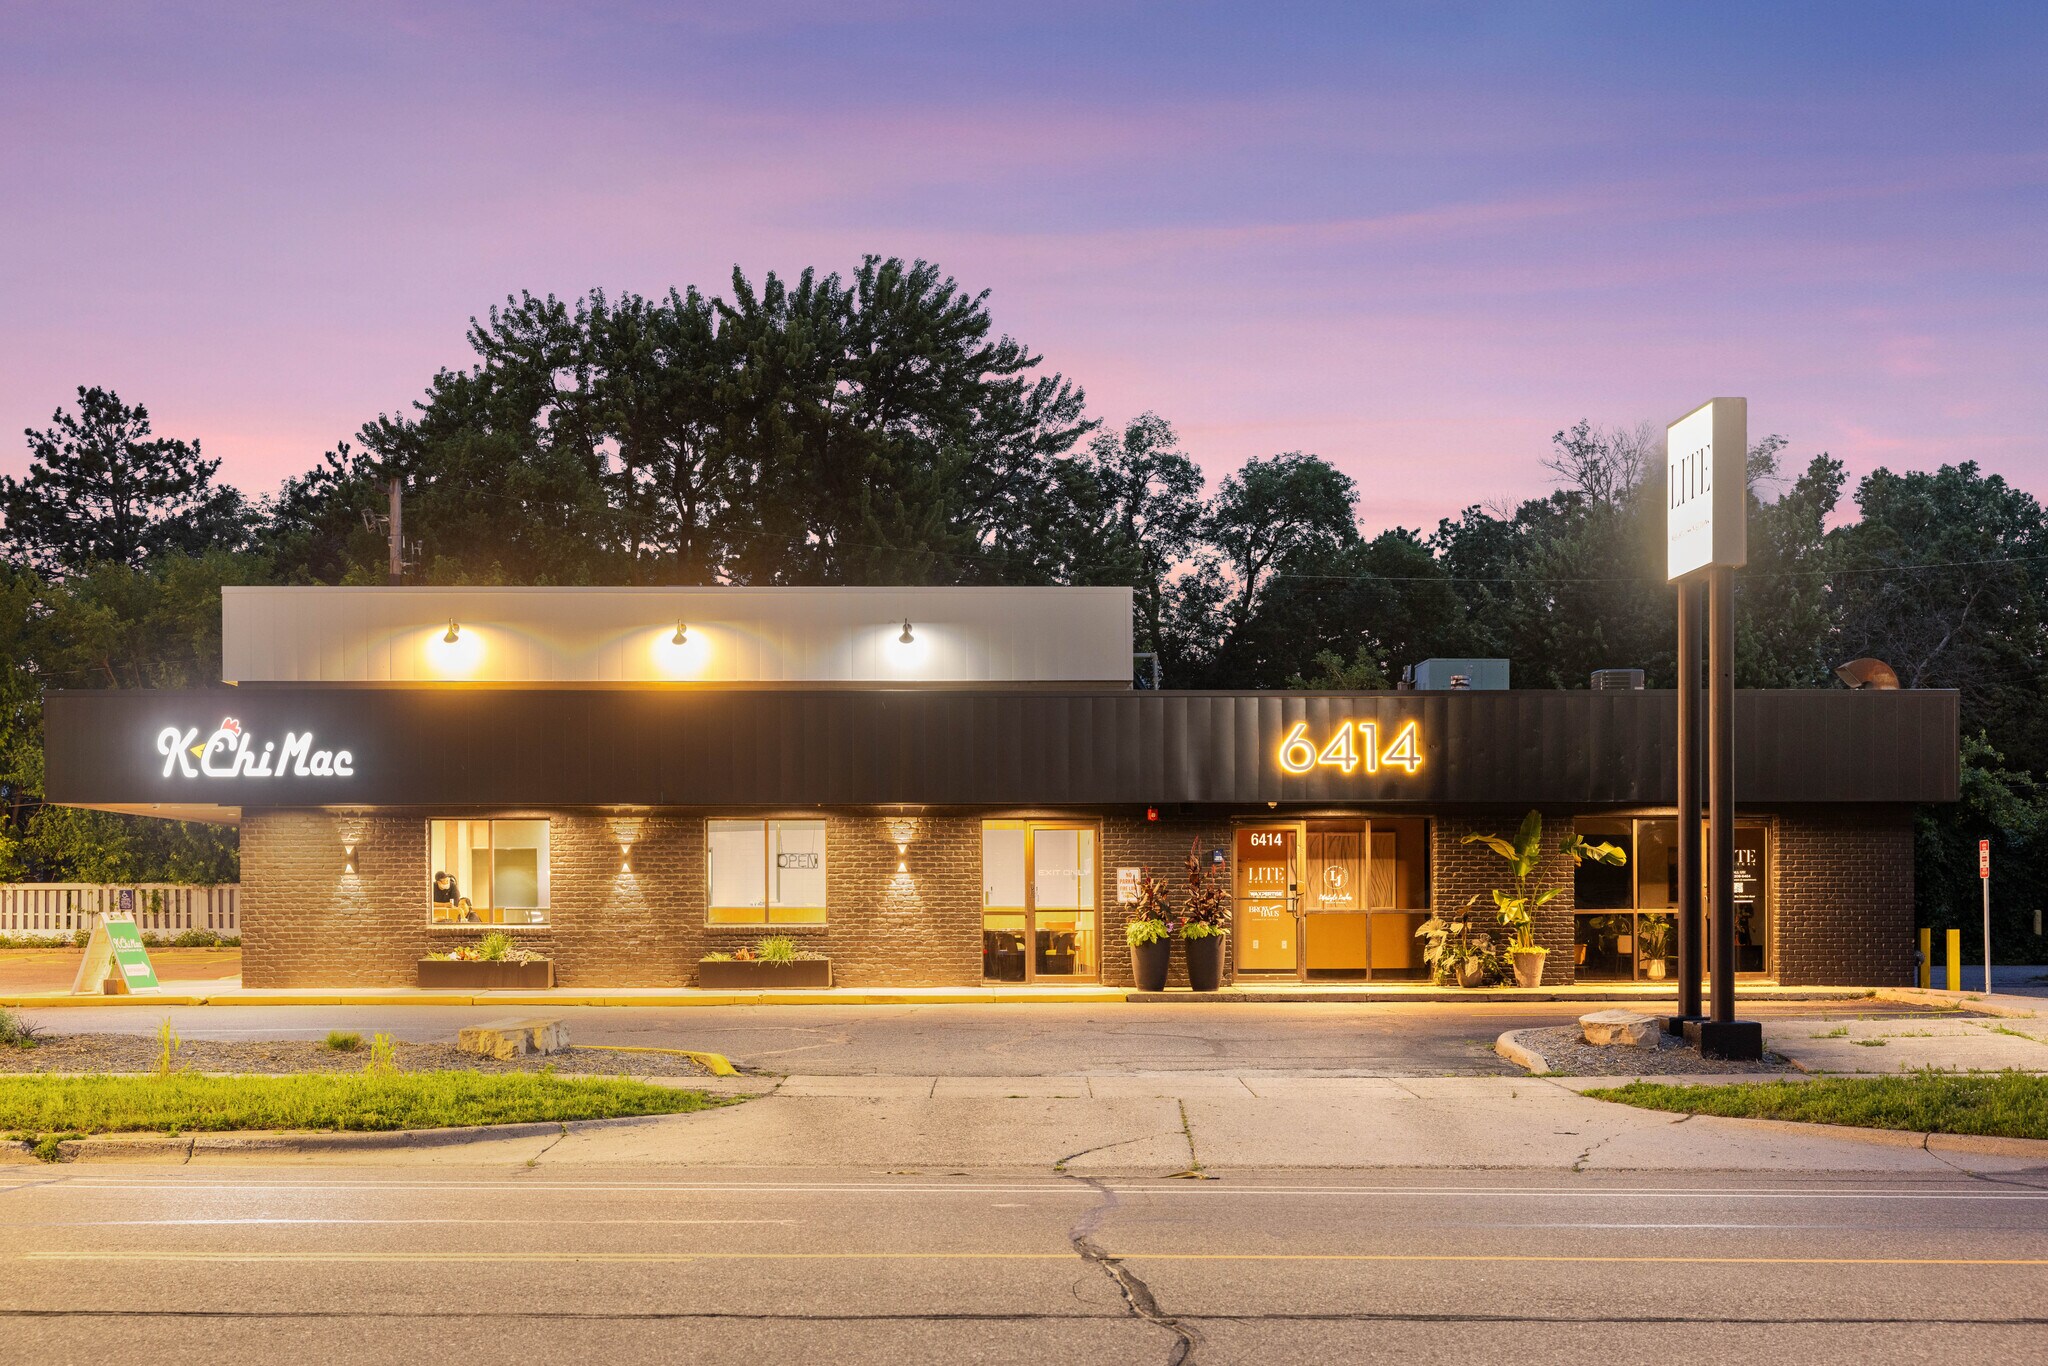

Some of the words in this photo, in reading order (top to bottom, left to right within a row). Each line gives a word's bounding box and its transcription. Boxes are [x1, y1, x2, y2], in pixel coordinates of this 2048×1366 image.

[1671, 444, 1710, 510] LITE
[1280, 722, 1422, 773] 6414
[1250, 832, 1283, 847] 6414
[777, 853, 817, 869] OPEN
[1734, 849, 1756, 863] TE
[1248, 867, 1285, 881] LITE
